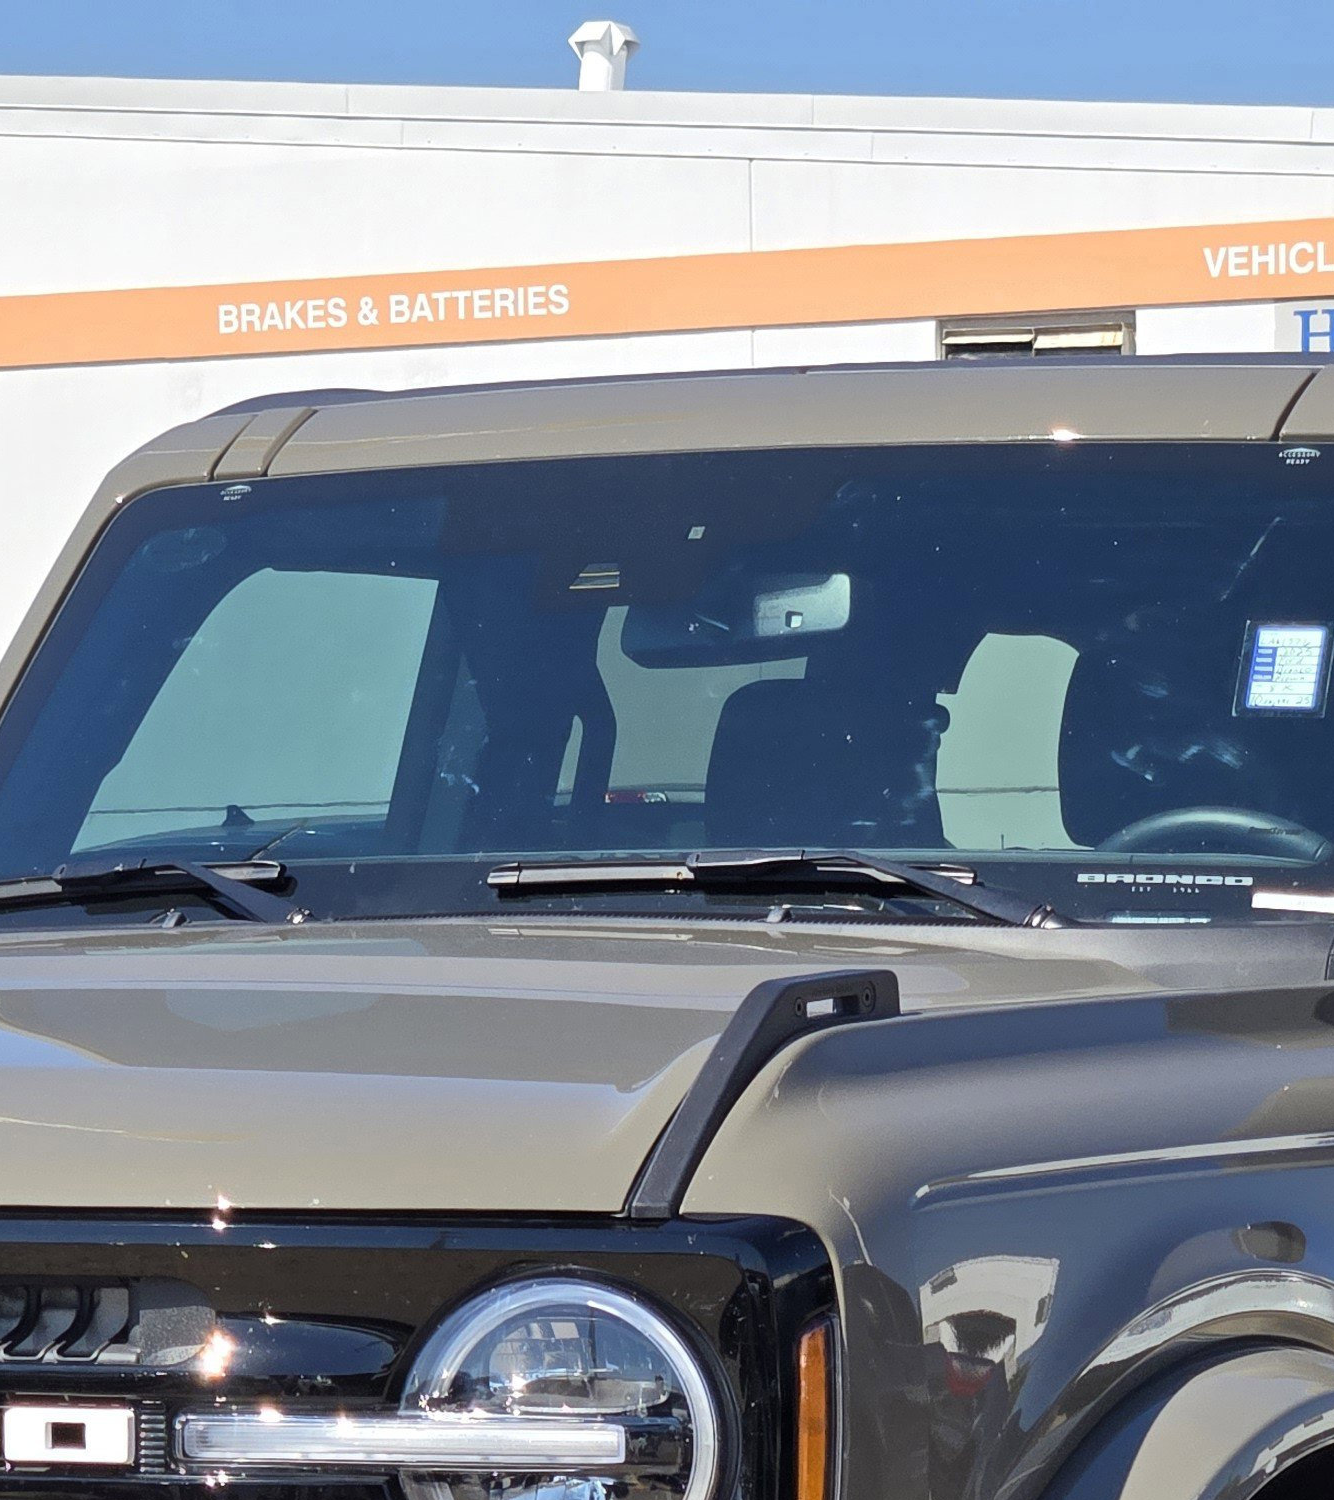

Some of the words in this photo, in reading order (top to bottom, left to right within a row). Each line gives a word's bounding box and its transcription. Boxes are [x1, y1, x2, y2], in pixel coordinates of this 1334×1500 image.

[218, 297, 348, 334] BRAKES
[357, 296, 380, 327] &
[388, 284, 570, 325] BATTERIES
